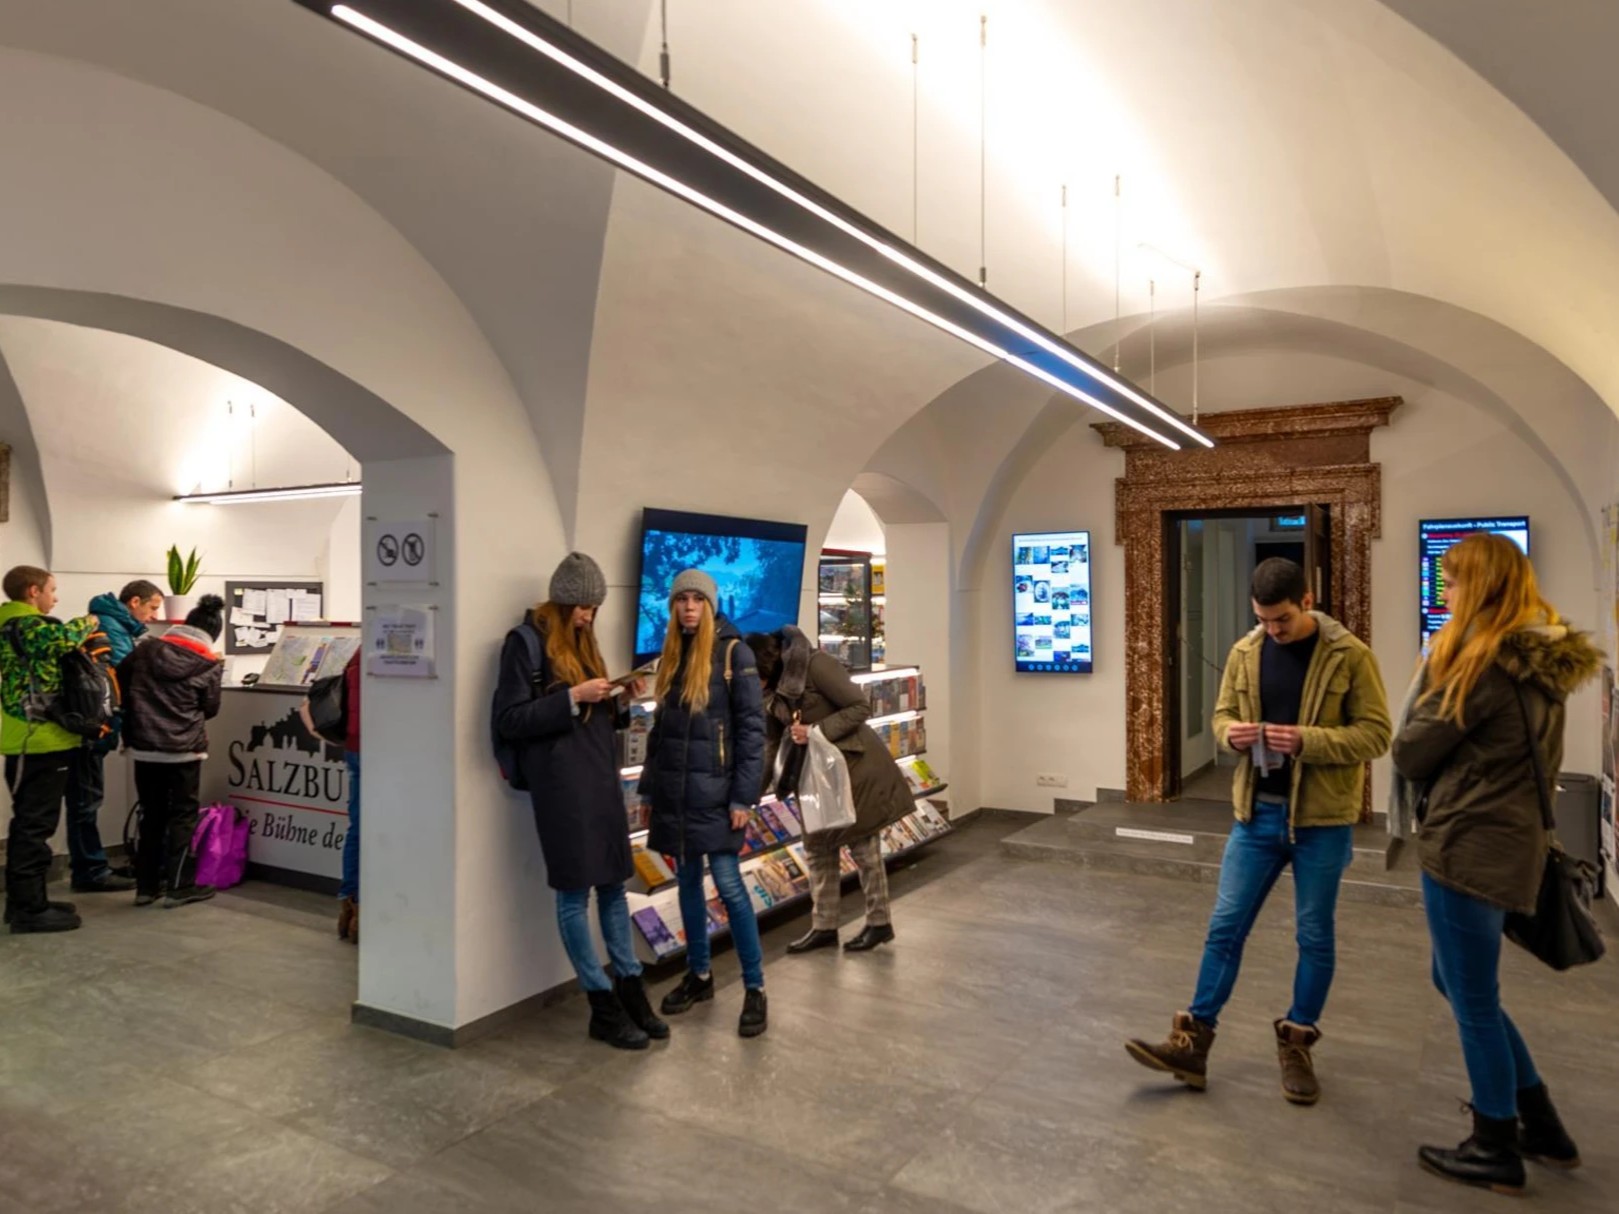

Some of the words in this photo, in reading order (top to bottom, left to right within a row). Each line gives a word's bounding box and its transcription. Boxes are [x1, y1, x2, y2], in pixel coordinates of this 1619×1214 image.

[228, 740, 349, 804] SALZBU
[262, 812, 319, 846] Bühne
[322, 821, 345, 850] de
